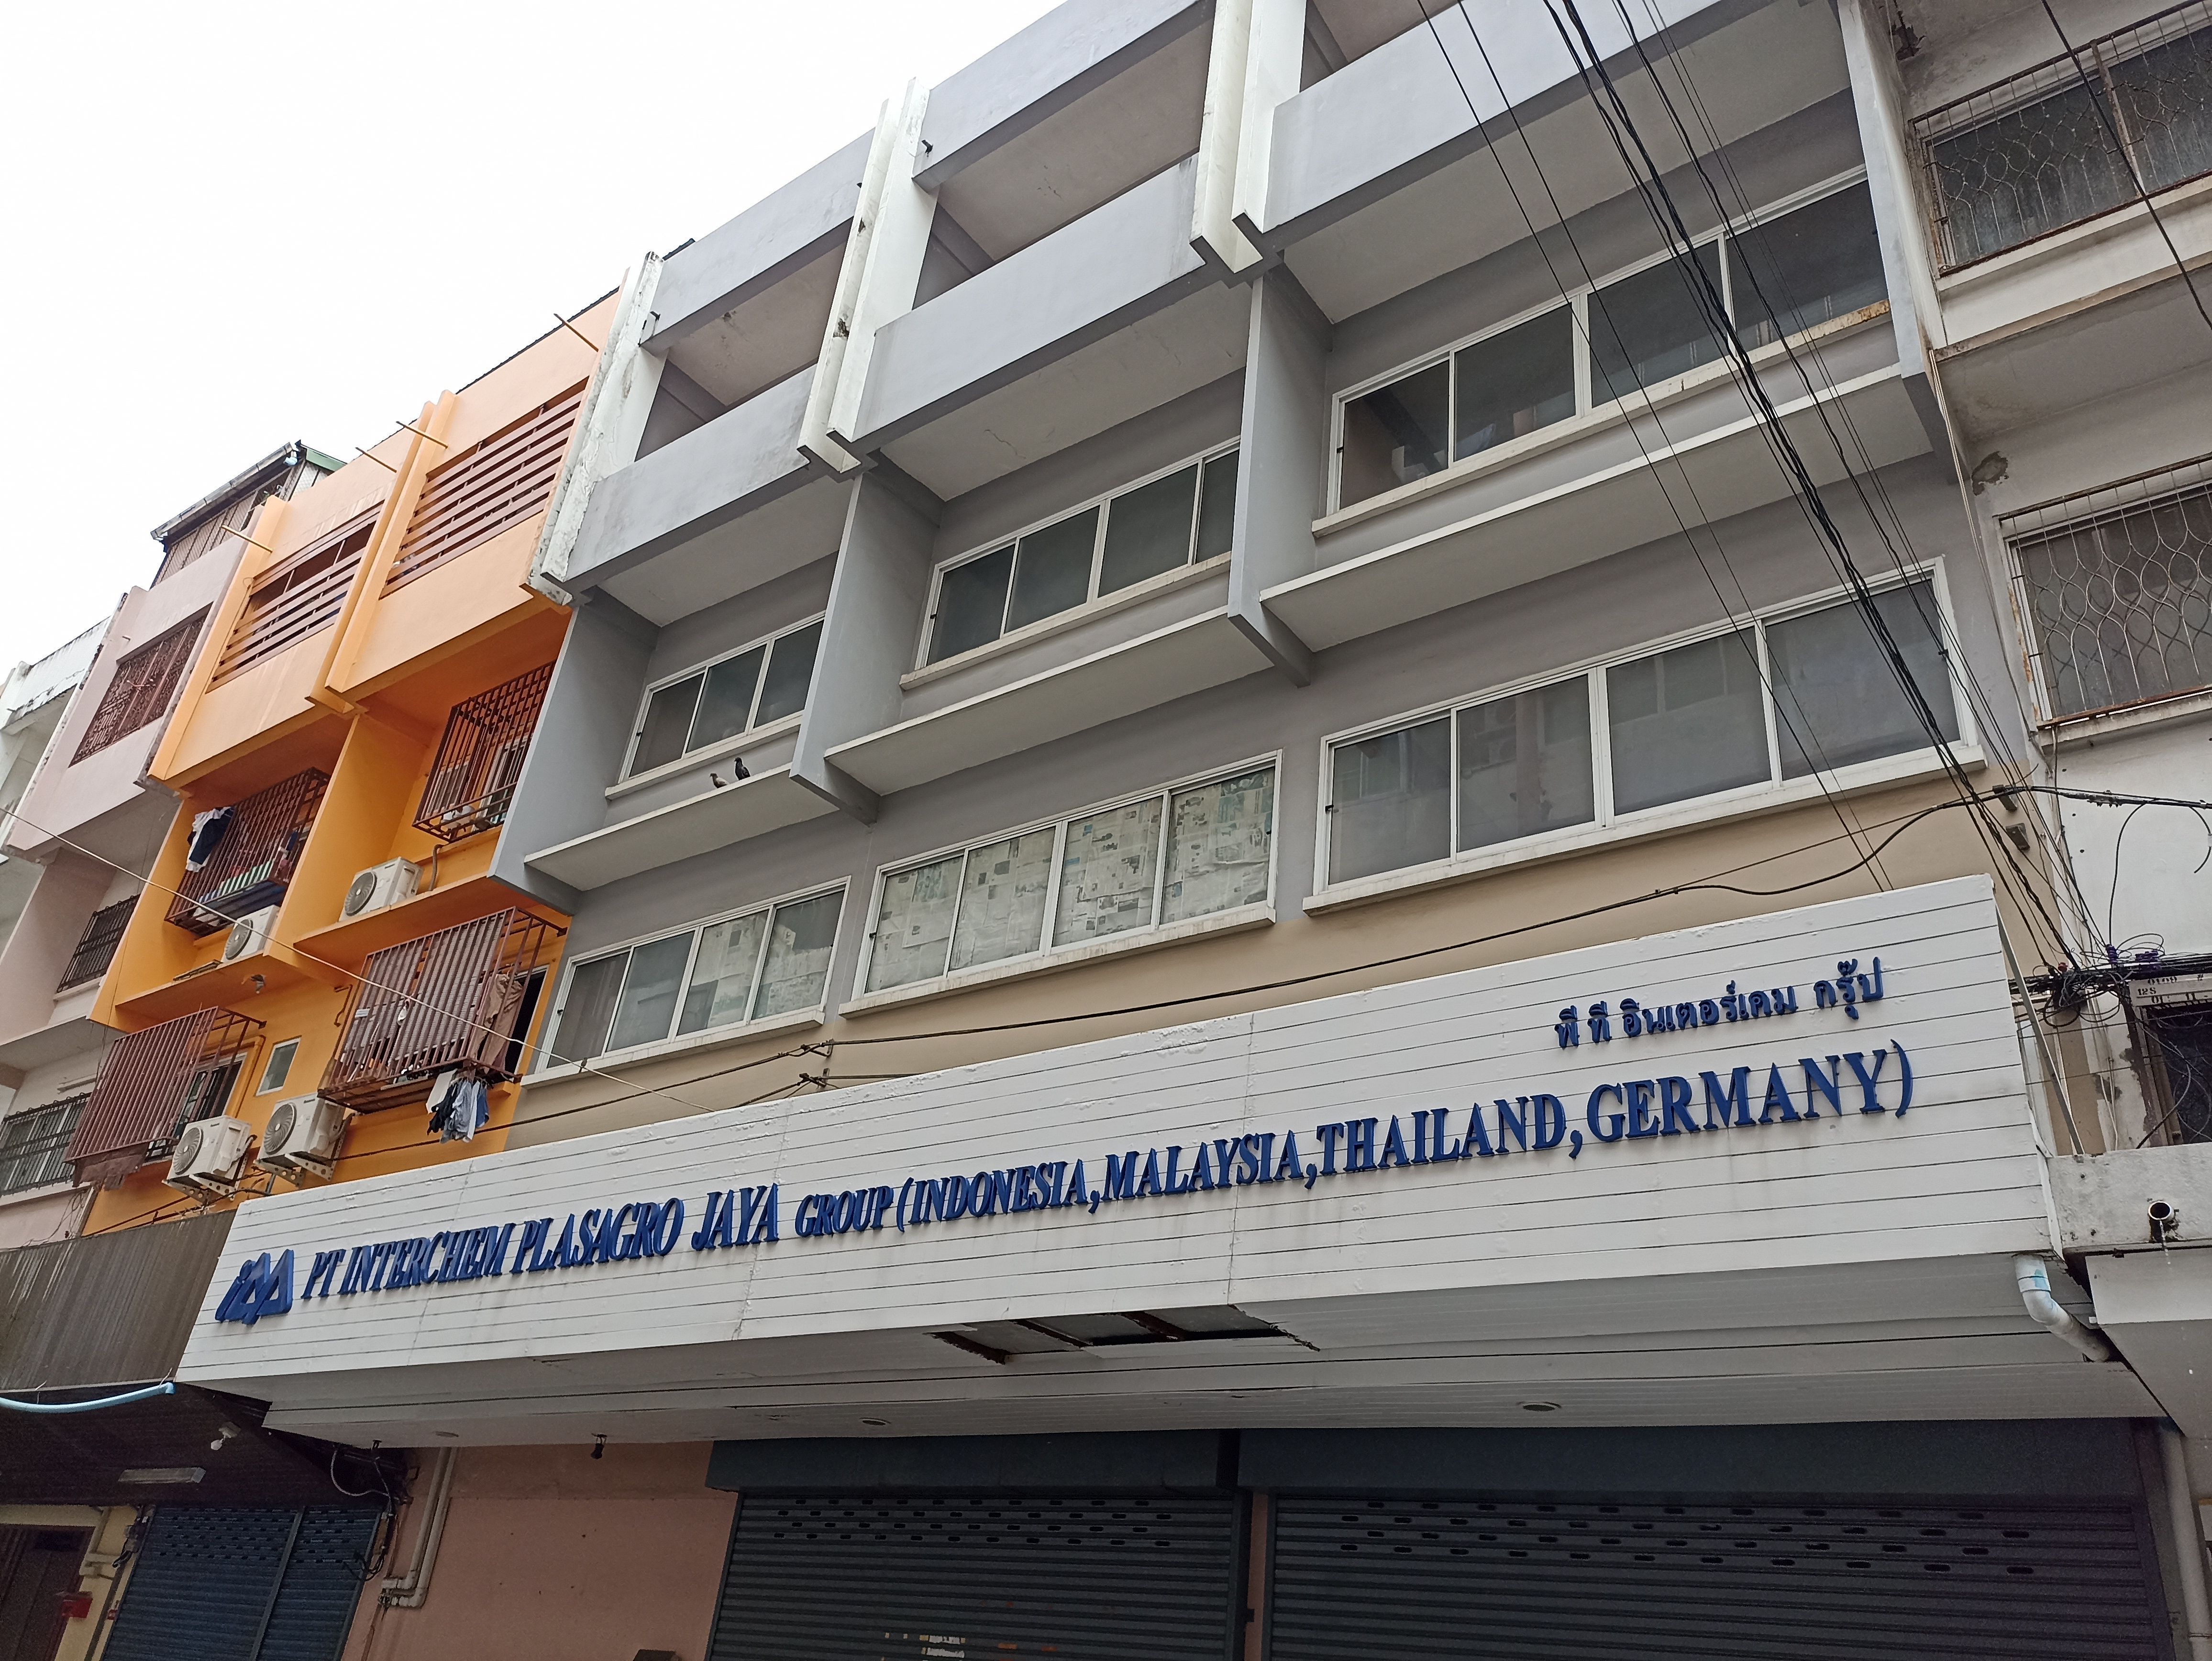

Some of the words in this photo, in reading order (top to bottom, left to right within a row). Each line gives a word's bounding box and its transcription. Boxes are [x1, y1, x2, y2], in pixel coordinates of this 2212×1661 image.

[1554, 1005, 1580, 1049] พี
[1587, 1000, 1612, 1043] ที
[1620, 980, 1799, 1038] อินเตอร์เคม
[1814, 957, 1884, 1019] กรุ๊ป
[301, 1248, 346, 1299] PT
[337, 1223, 515, 1295] INTERCHEM
[509, 1197, 685, 1274] PLASAGRO
[690, 1183, 780, 1251] JAYA
[795, 1185, 895, 1238] GROUP
